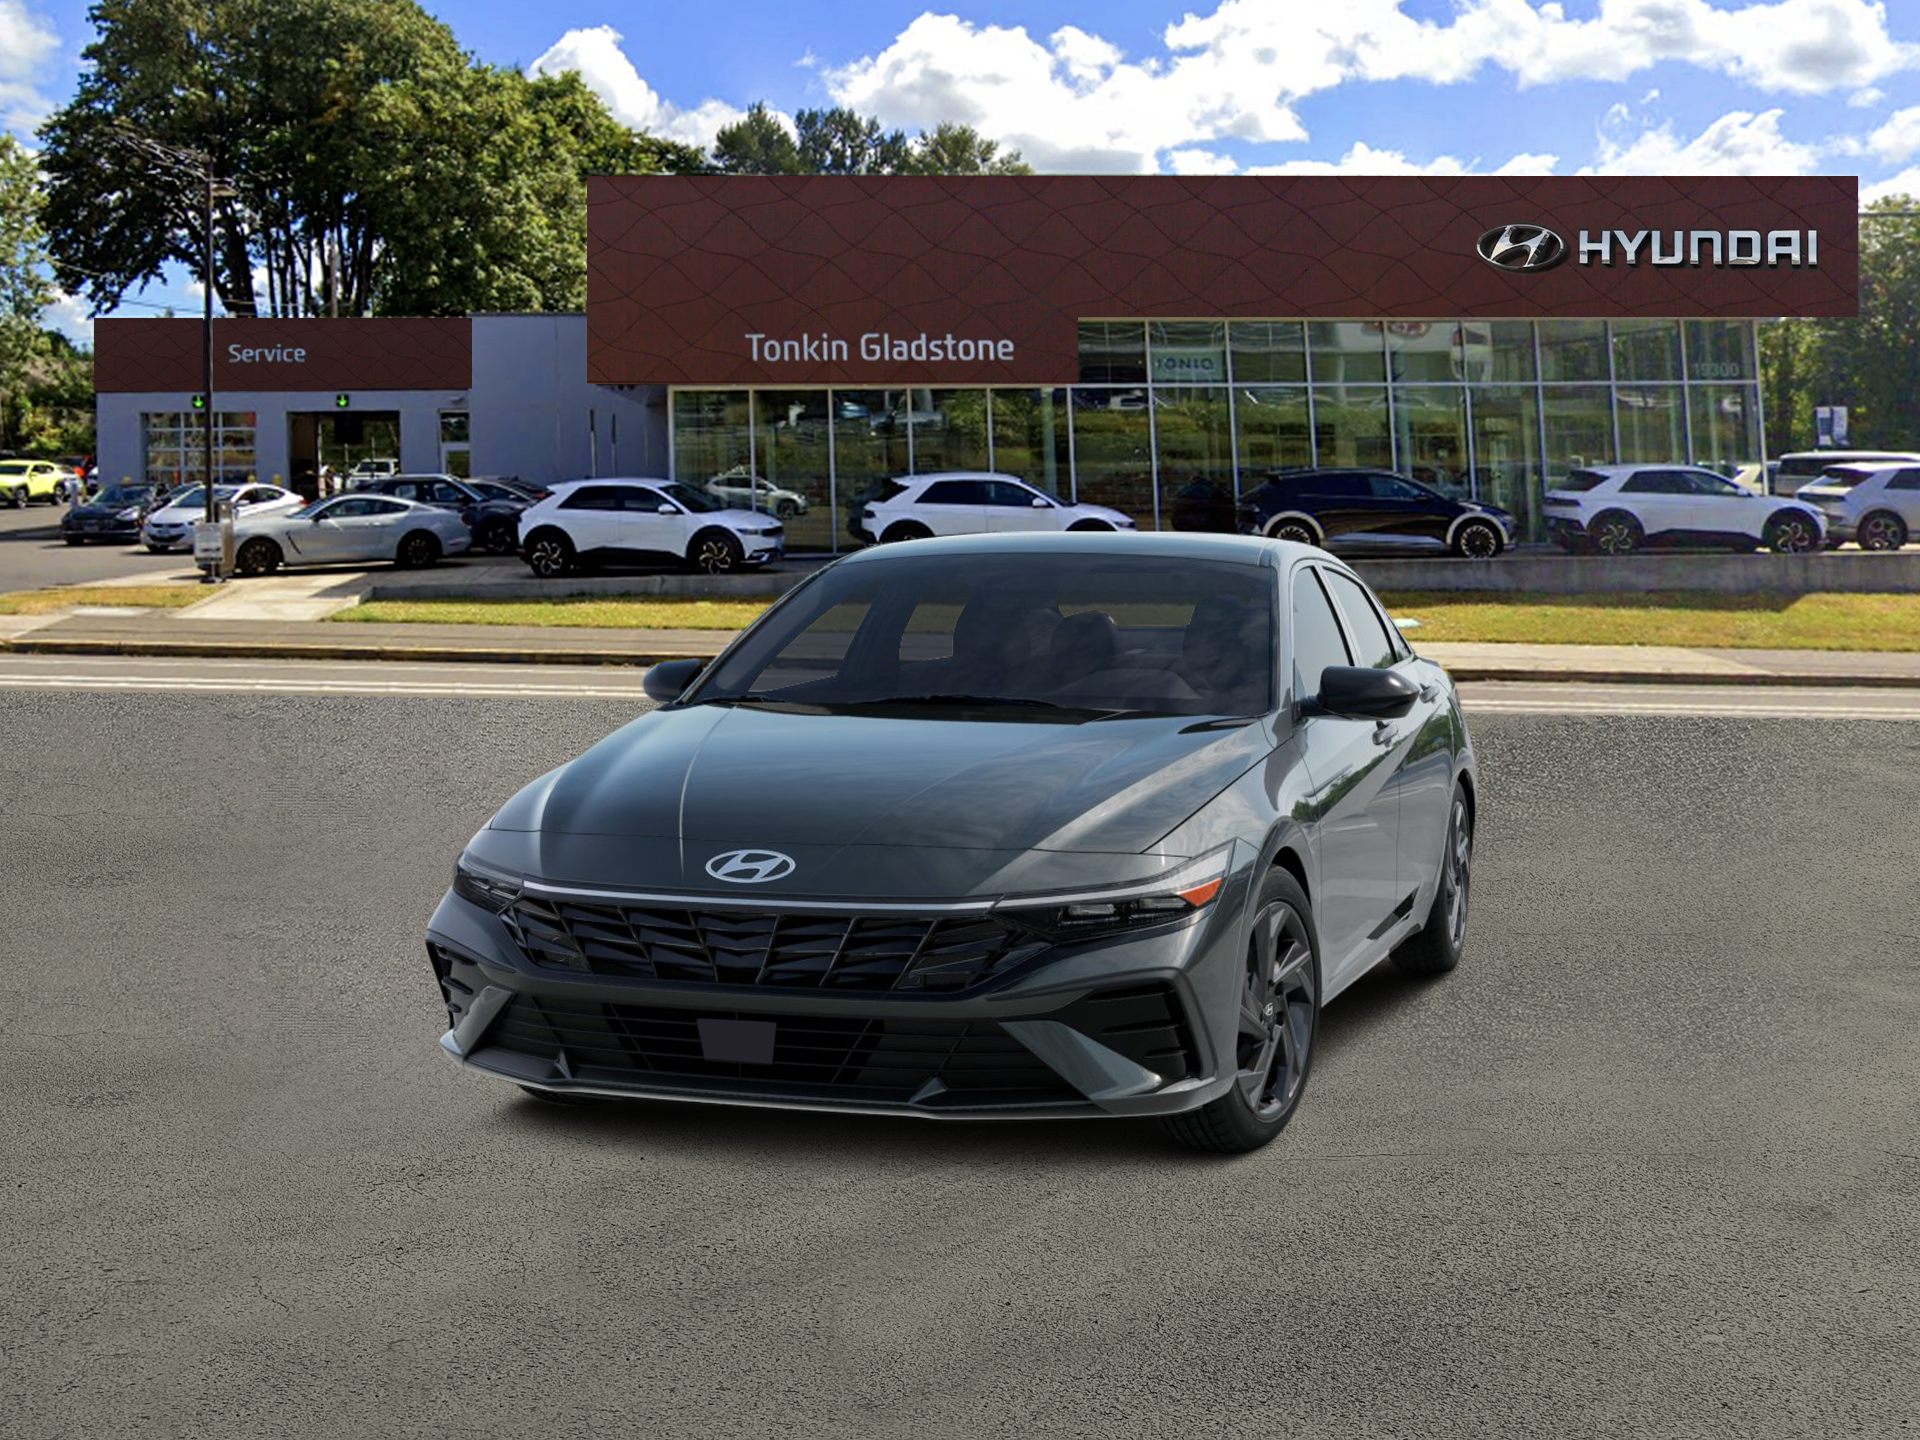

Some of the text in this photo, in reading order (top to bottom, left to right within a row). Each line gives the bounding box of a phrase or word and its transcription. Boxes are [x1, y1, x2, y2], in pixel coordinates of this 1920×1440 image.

[1579, 229, 1818, 265] HYUNDAI
[228, 343, 307, 363] Service
[744, 332, 1014, 362] Tonkin Gladstone
